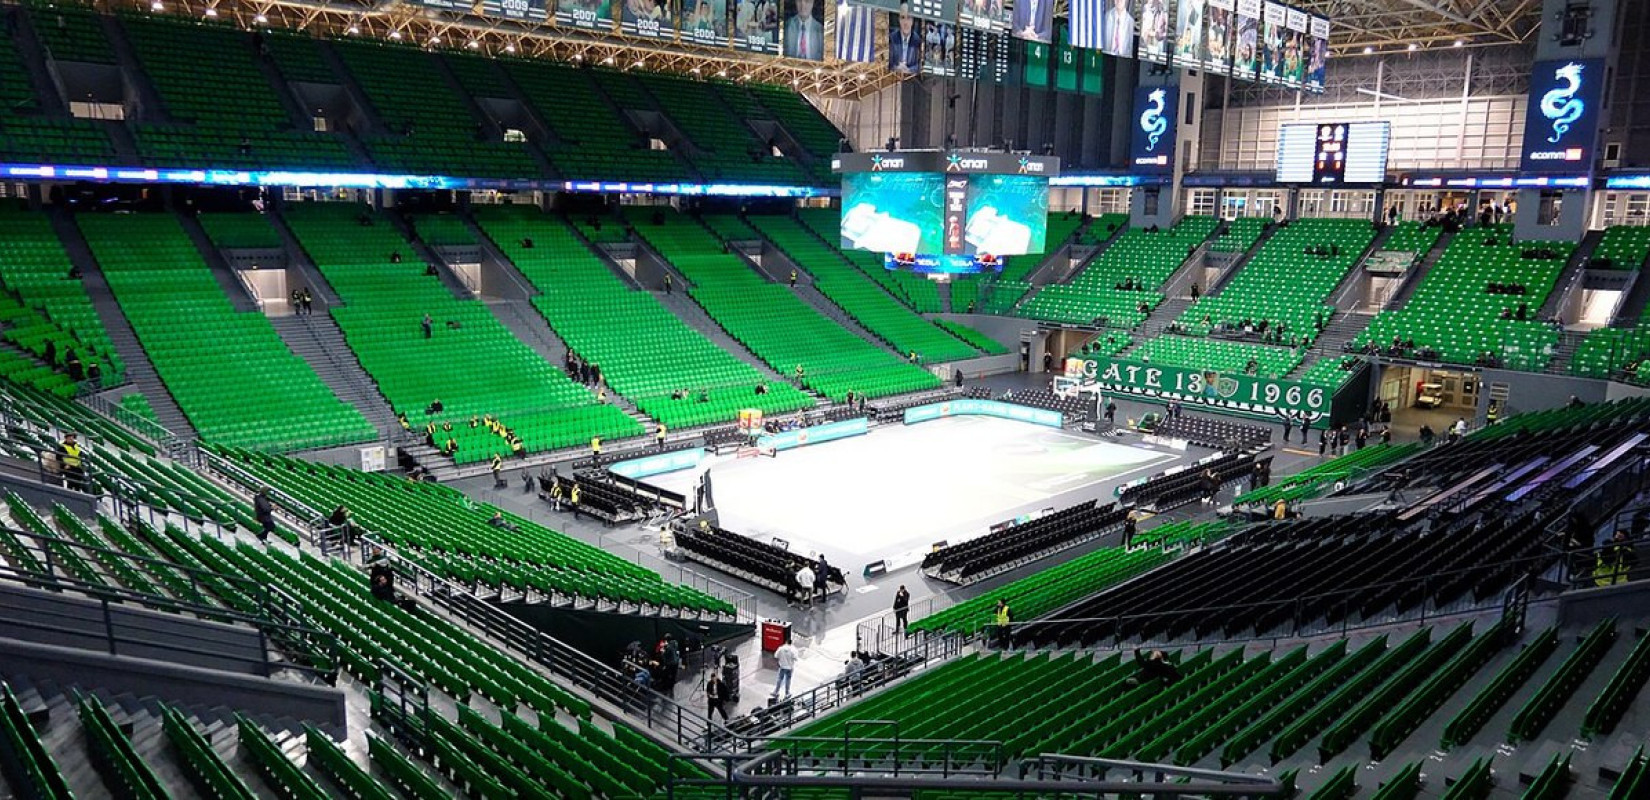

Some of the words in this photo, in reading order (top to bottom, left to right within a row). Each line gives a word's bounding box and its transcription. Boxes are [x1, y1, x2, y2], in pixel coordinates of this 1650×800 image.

[502, 0, 528, 11] 2009
[572, 9, 596, 21] 2007
[637, 18, 660, 30] 2002
[1034, 45, 1041, 58] 4
[1063, 50, 1072, 65] 13
[1081, 358, 1163, 388] GATE
[1175, 371, 1203, 393] 13
[1250, 381, 1324, 409] 1966
